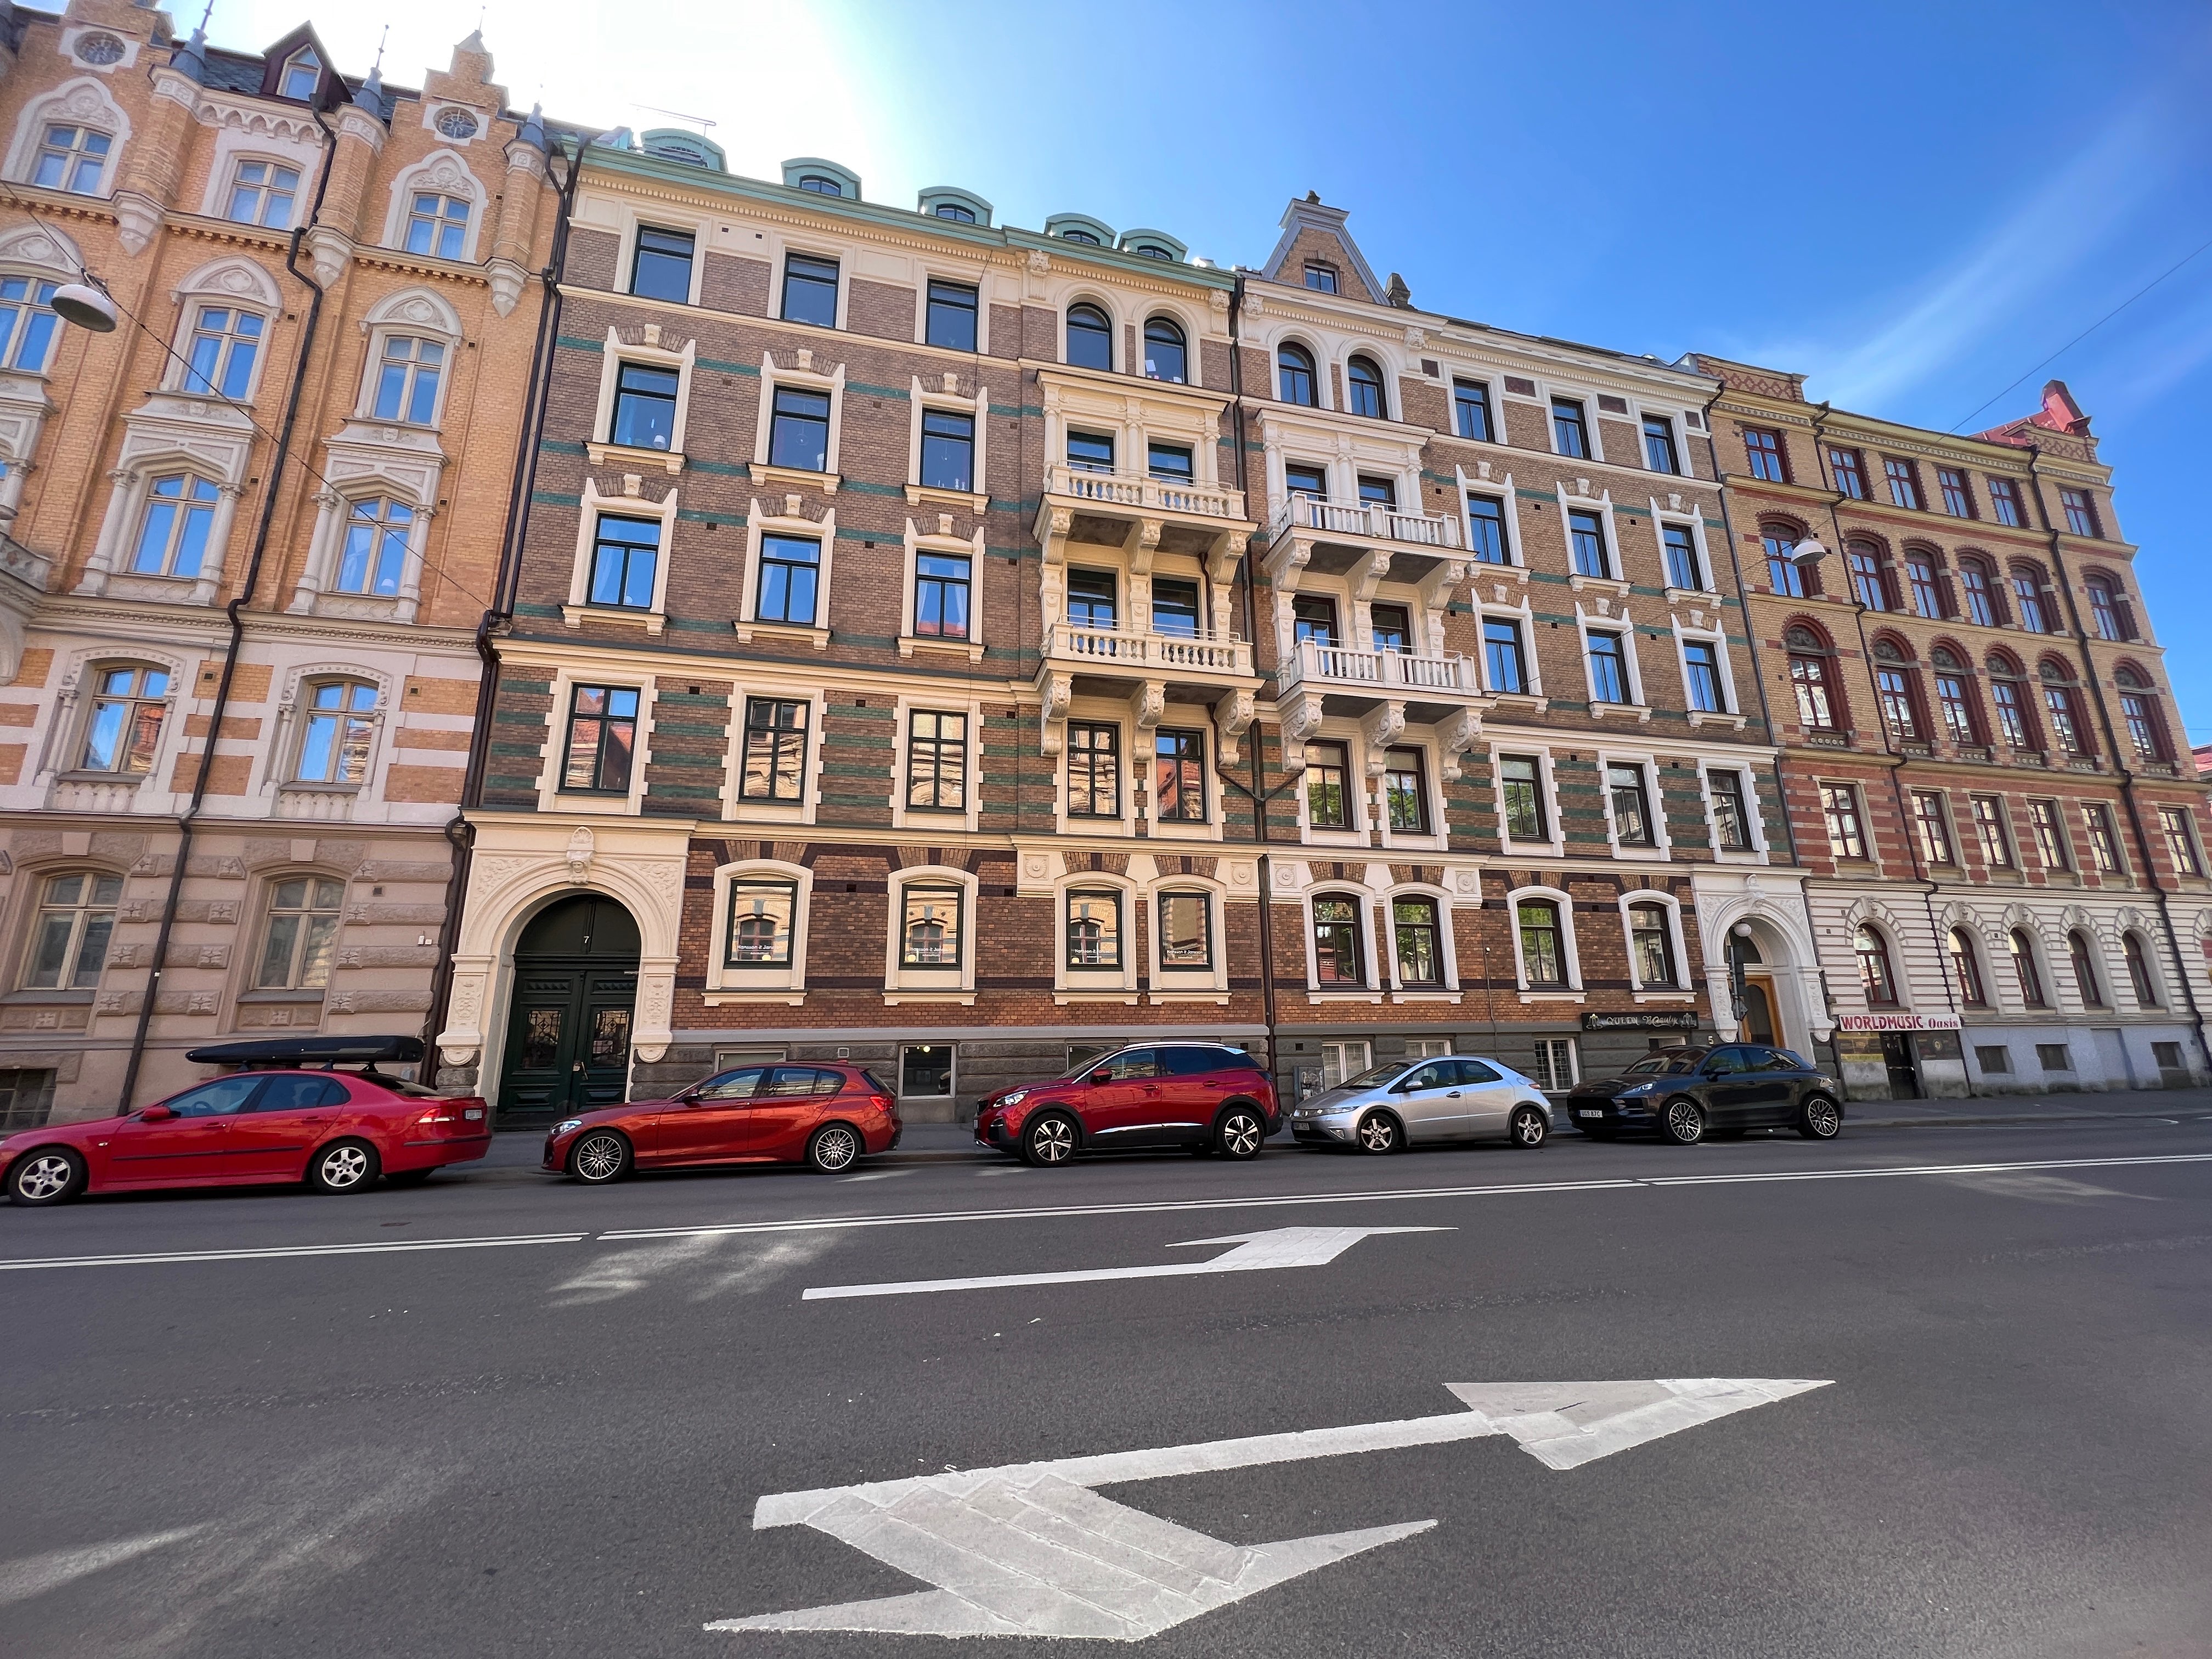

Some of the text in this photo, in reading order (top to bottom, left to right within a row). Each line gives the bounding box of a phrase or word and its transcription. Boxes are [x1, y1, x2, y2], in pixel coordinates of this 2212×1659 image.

[583, 935, 590, 944] 7
[1606, 1017, 1640, 1025] QUEEN
[1841, 1016, 1959, 1030] WORLDMUSIC Oasis
[1708, 1036, 1714, 1045] 5
